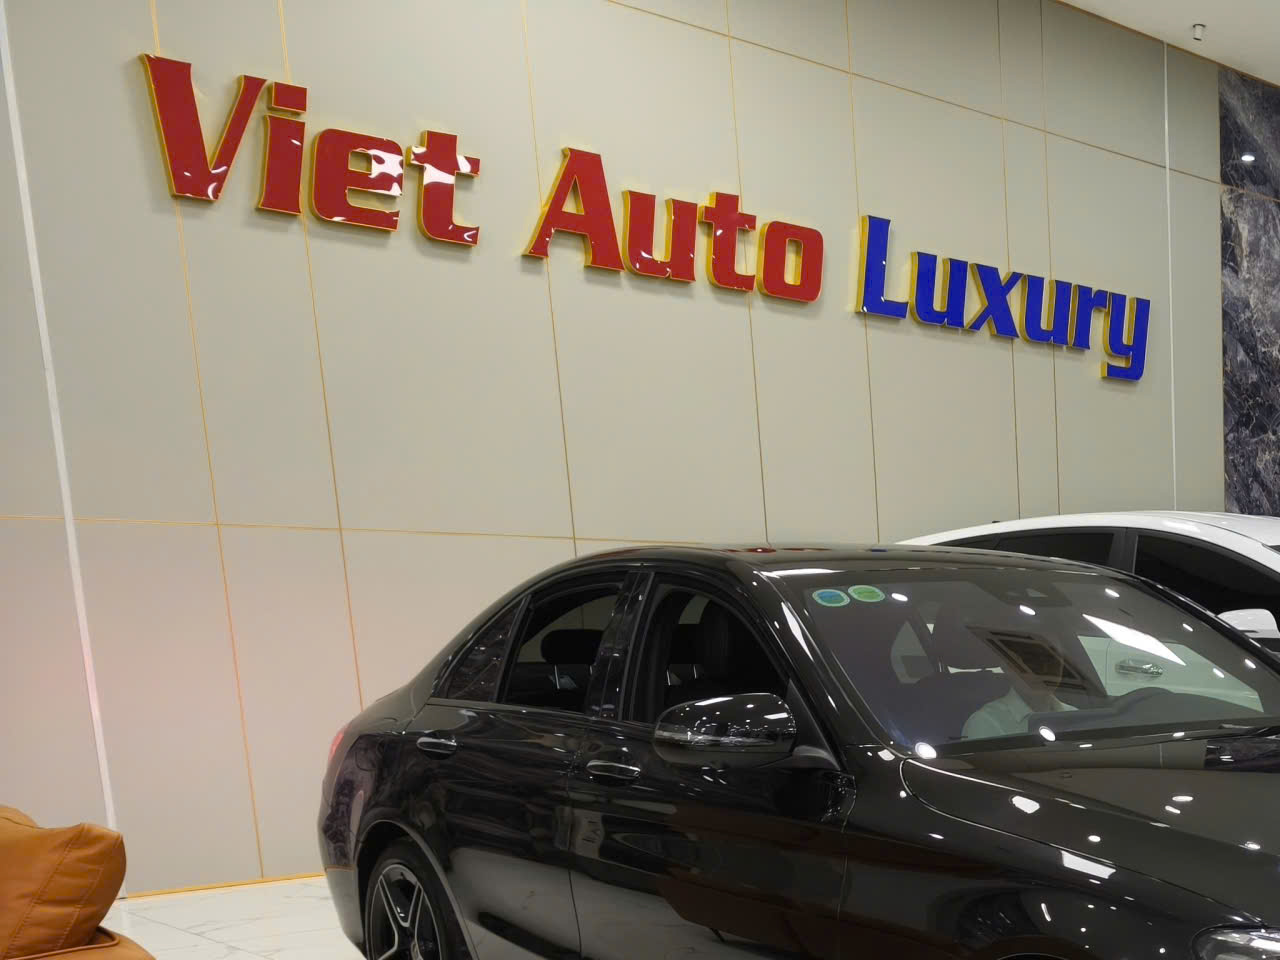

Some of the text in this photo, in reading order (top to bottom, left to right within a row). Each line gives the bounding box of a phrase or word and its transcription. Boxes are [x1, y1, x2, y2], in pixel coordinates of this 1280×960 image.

[139, 53, 1151, 381] Viet Auto Luxury
